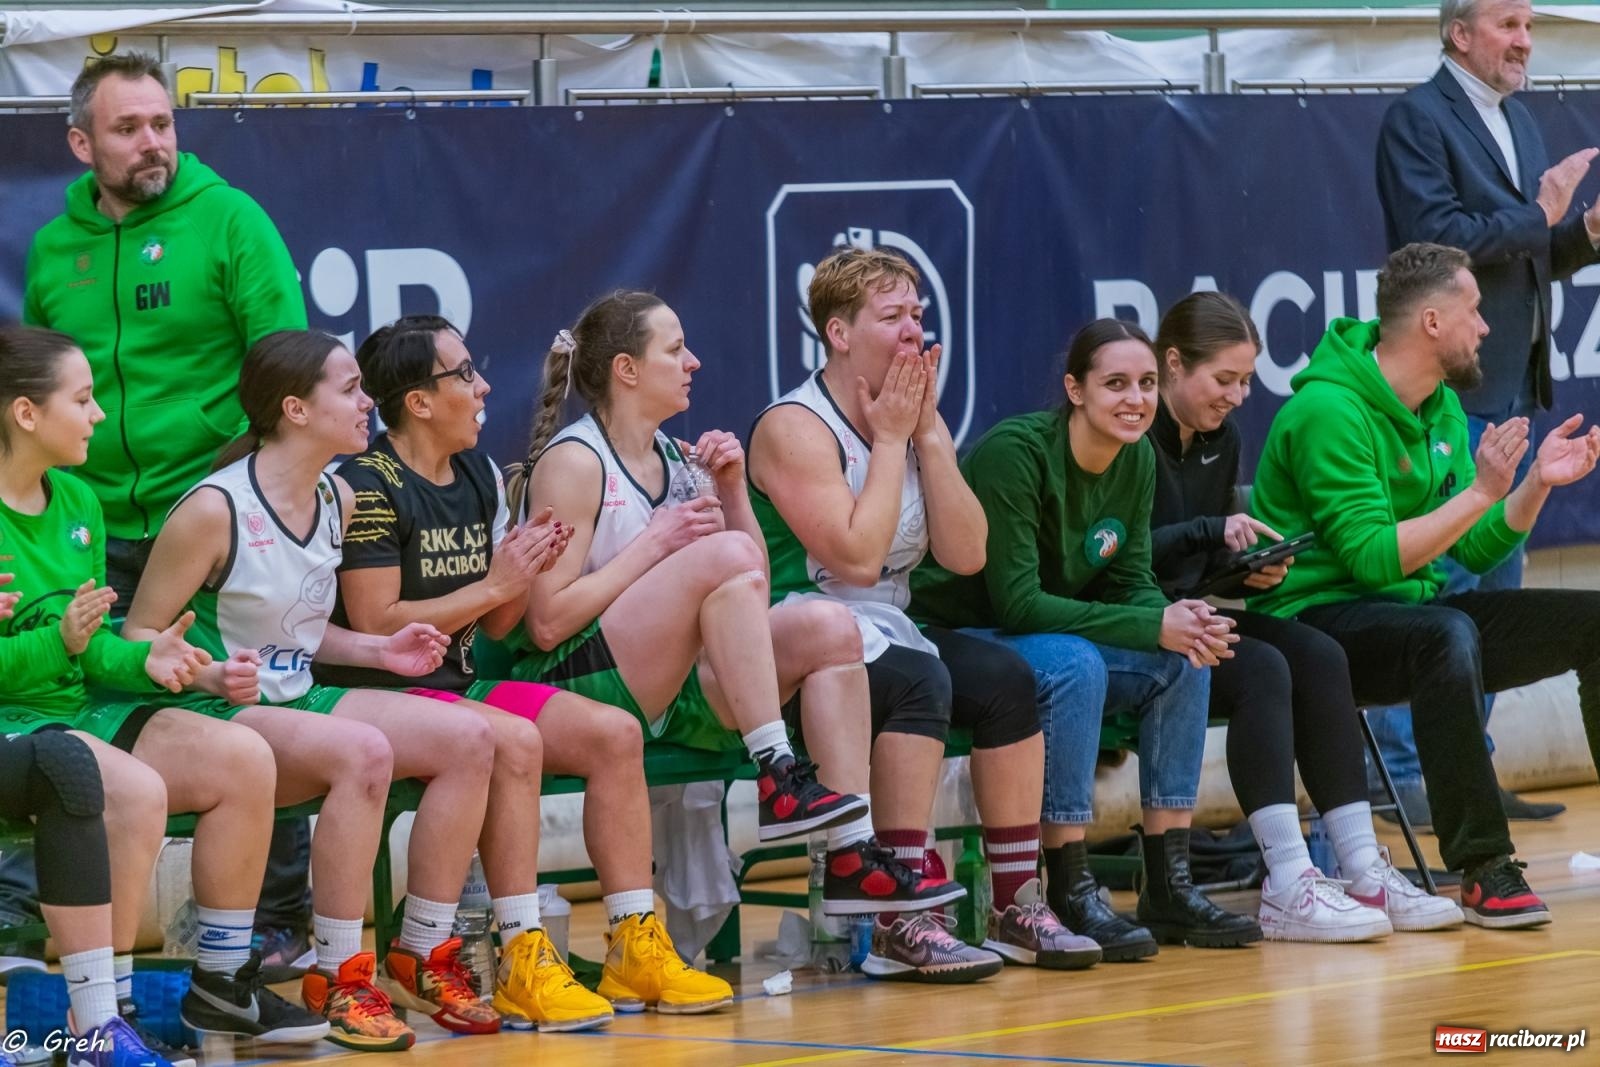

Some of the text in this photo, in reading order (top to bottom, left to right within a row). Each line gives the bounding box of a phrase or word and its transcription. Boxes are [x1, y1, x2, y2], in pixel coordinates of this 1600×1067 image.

[136, 280, 170, 311] GW
[420, 527, 460, 553] RKK
[206, 929, 230, 940] NIKE
